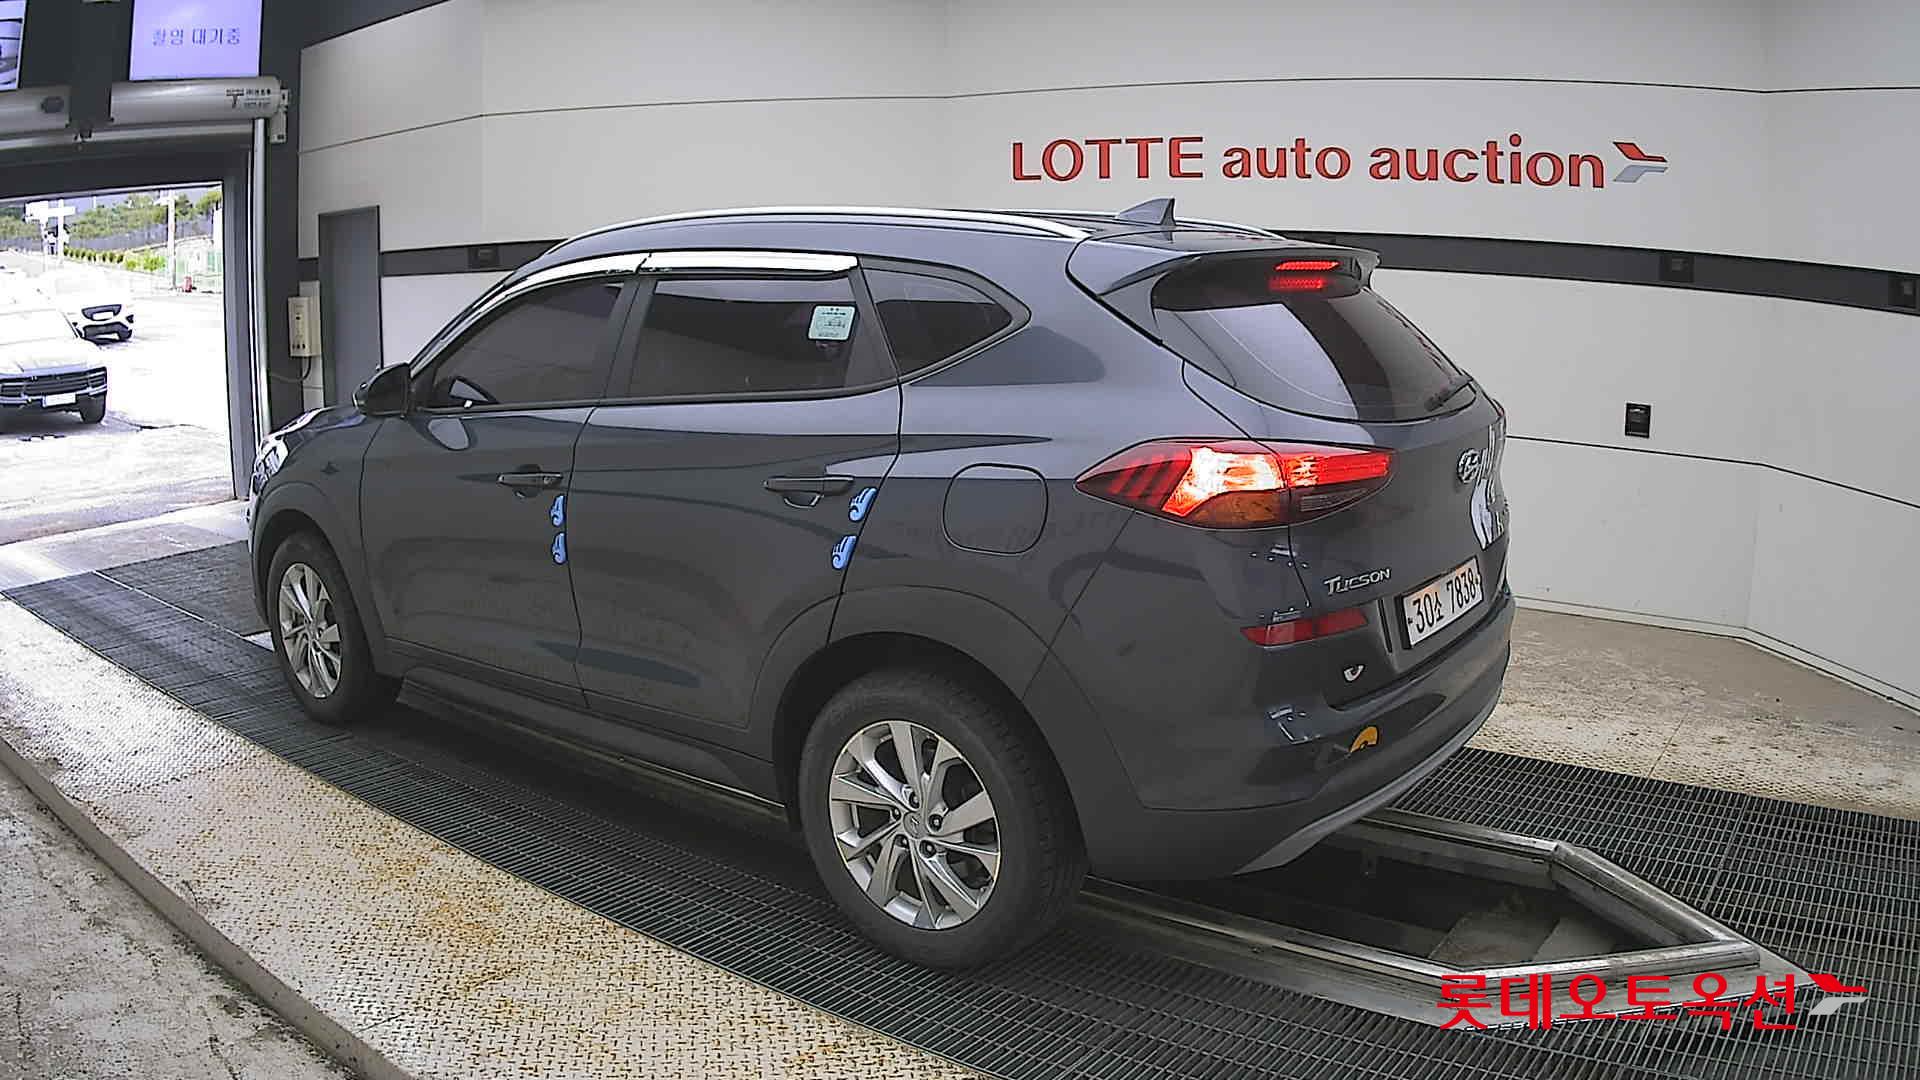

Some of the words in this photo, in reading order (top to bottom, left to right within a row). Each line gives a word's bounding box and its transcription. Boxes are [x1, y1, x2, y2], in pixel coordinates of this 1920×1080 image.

[192, 27, 240, 46] 대기중
[1011, 136, 1205, 182] LOTTE
[1222, 137, 1353, 182] auto
[1368, 133, 1606, 189] auction
[1324, 568, 1392, 597] TUCSON
[1412, 591, 1444, 634] 30소
[1446, 567, 1477, 615] 7838
